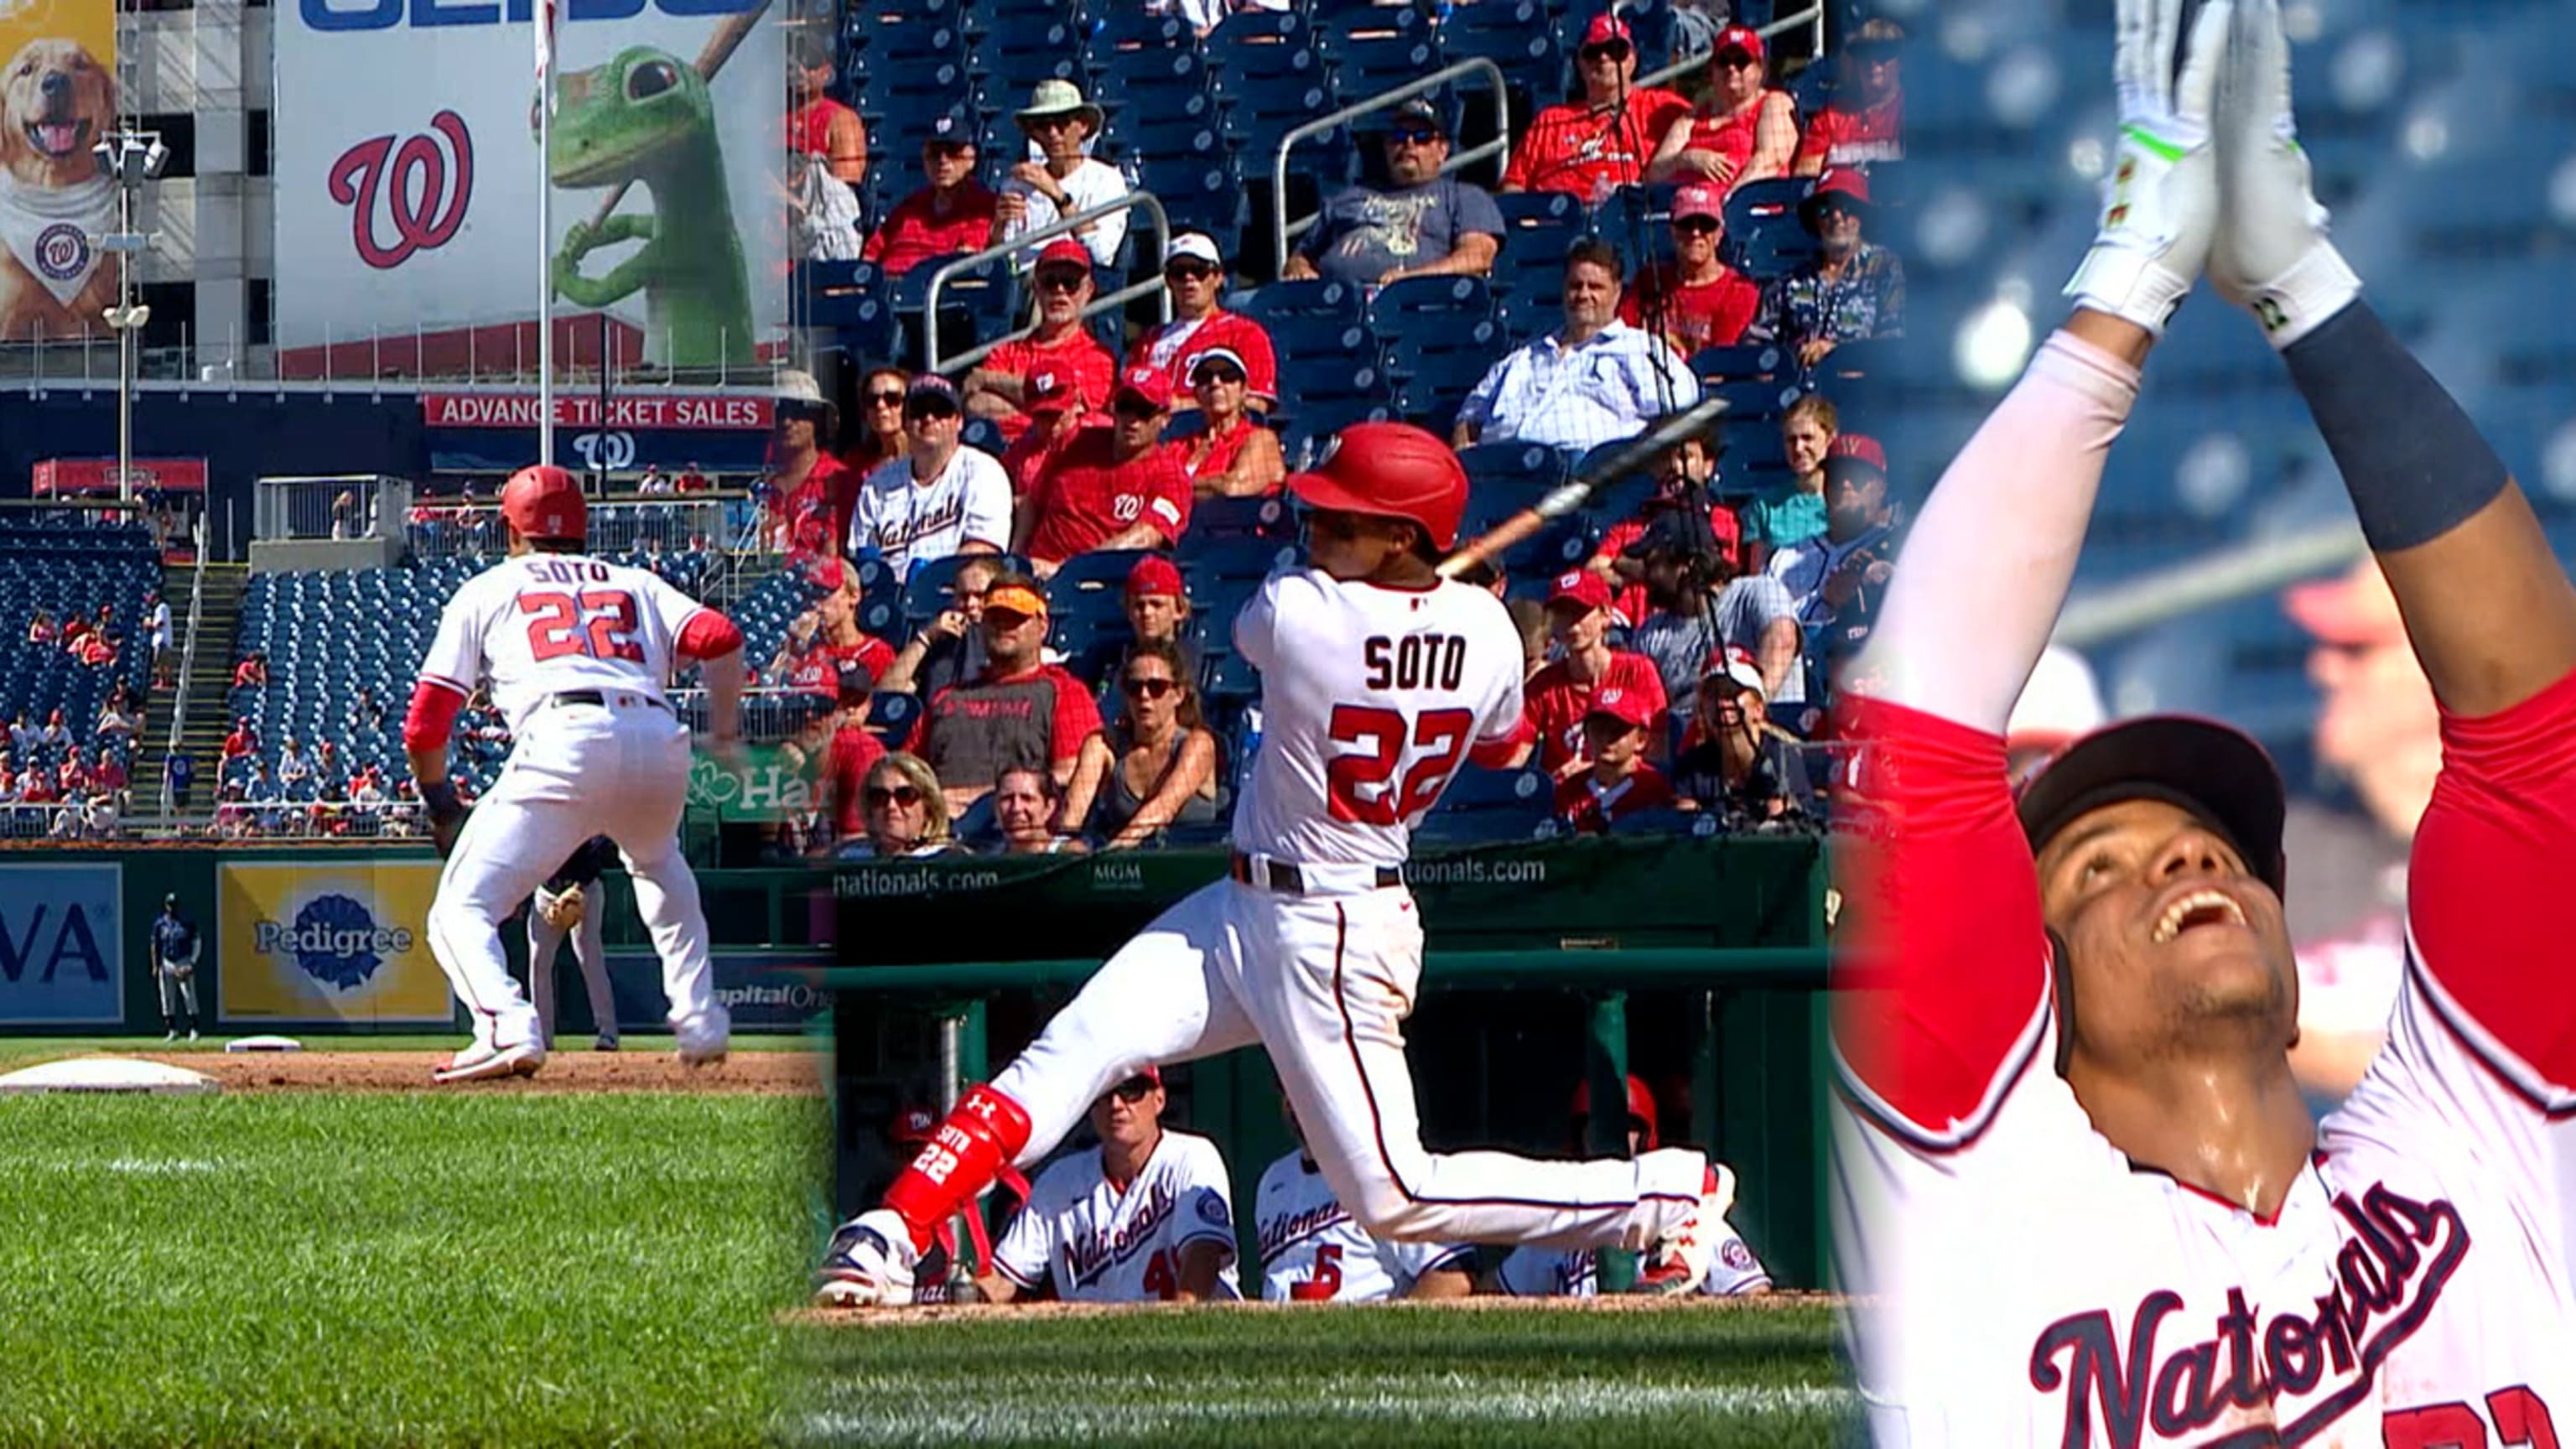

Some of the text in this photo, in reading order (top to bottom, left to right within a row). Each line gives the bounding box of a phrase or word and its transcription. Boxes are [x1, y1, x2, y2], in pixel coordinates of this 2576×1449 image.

[329, 110, 473, 268] W
[442, 398, 758, 425] ADVANCE TICKET SALES
[525, 559, 610, 584] SOTO
[517, 589, 647, 663] 22
[1364, 634, 1467, 691] SOTO
[1327, 704, 1473, 827] 22
[255, 920, 413, 958] Pedigree
[912, 1142, 959, 1187] 22
[2029, 1181, 2471, 1449] Natonals
